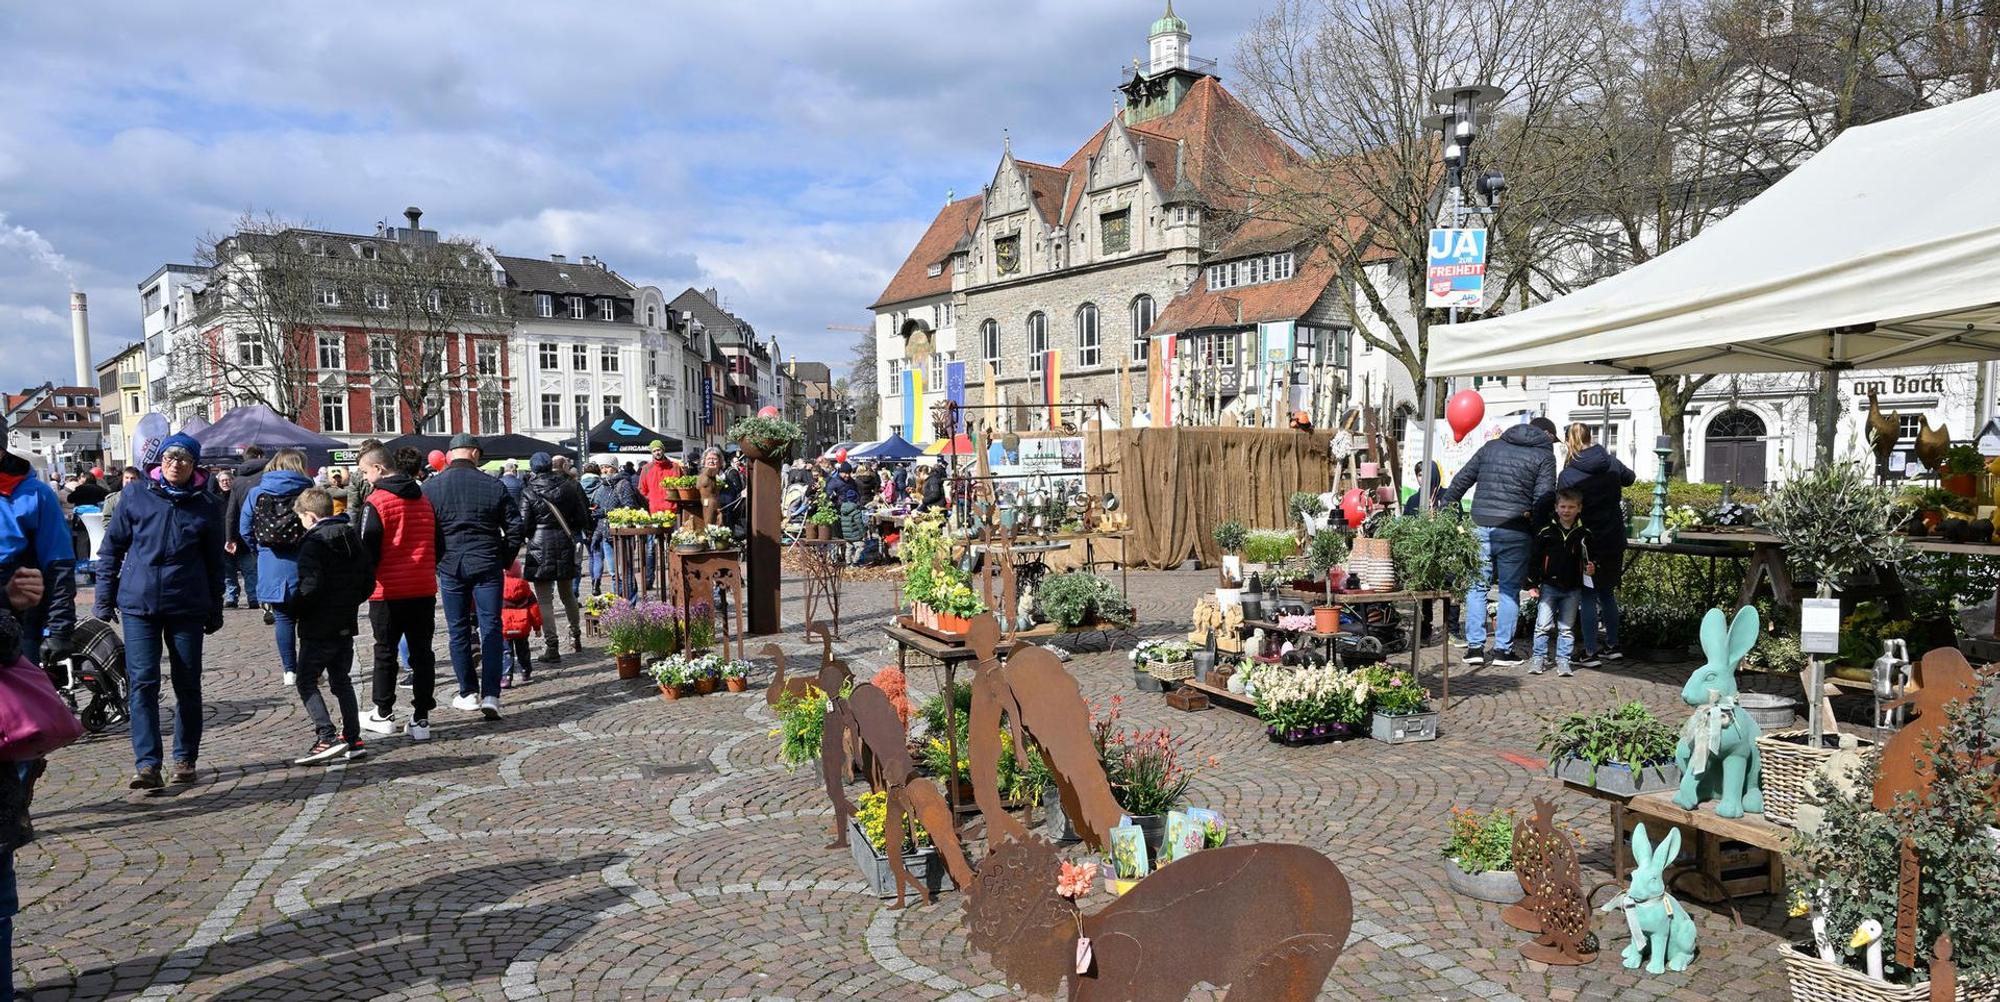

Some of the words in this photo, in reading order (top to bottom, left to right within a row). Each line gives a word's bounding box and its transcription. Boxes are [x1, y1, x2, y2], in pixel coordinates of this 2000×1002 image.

[1431, 230, 1479, 259] JA
[1429, 264, 1483, 278] FREIHEIT
[1854, 380, 1887, 396] am
[1893, 373, 1945, 394] Bock
[1577, 387, 1627, 407] Gaffel
